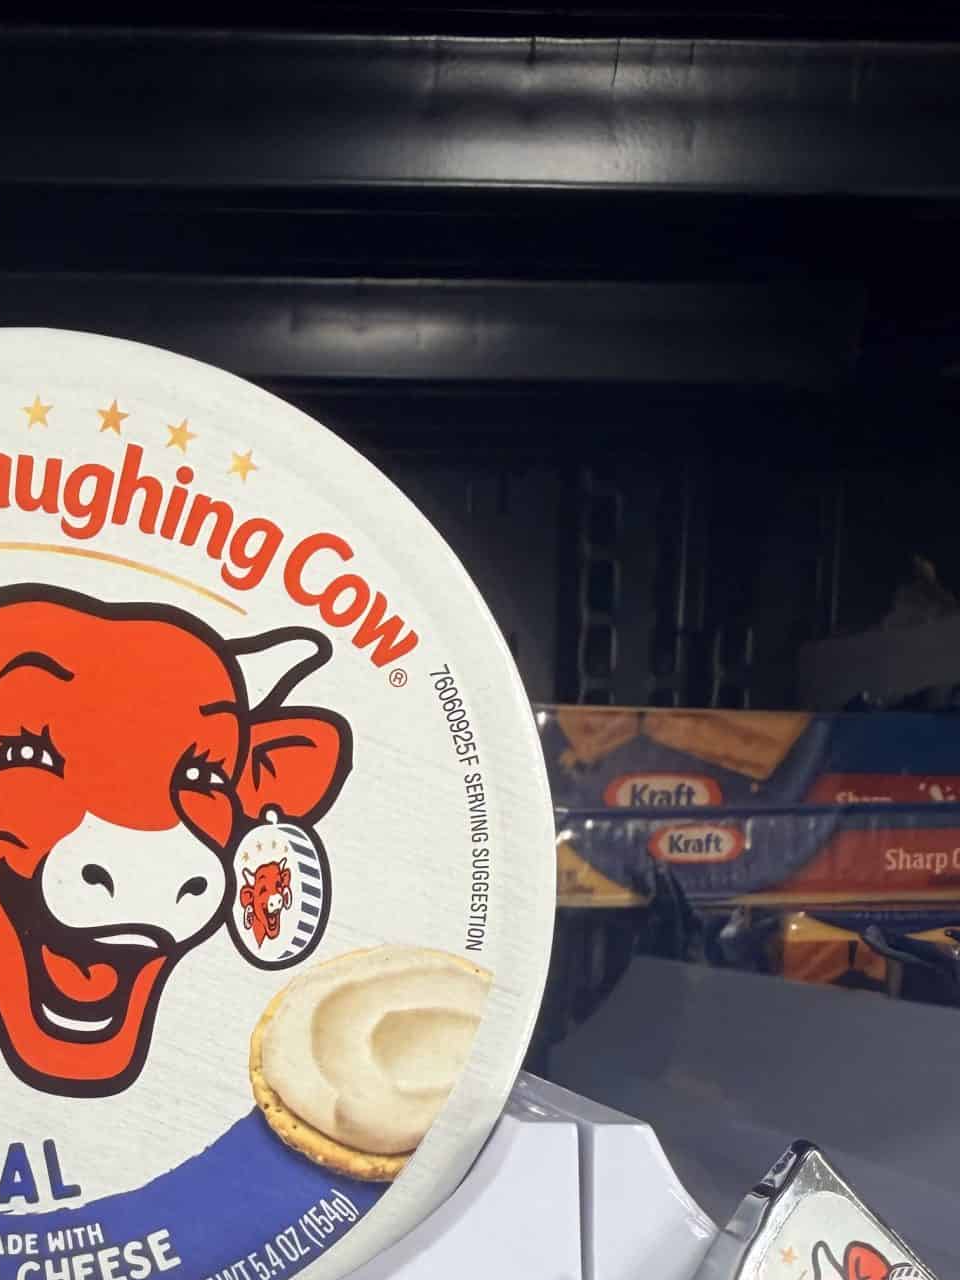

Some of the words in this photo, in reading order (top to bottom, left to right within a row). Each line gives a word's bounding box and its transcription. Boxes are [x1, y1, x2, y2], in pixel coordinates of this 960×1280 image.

[429, 664, 480, 766] 76060925F
[464, 773, 488, 842] SERVING
[668, 833, 722, 853] Kraft
[884, 847, 948, 875] Sharp
[465, 848, 489, 951] SUGGESTION
[47, 1223, 105, 1250] WITH
[275, 1226, 311, 1262] OZ
[298, 1188, 360, 1248] (154g)
